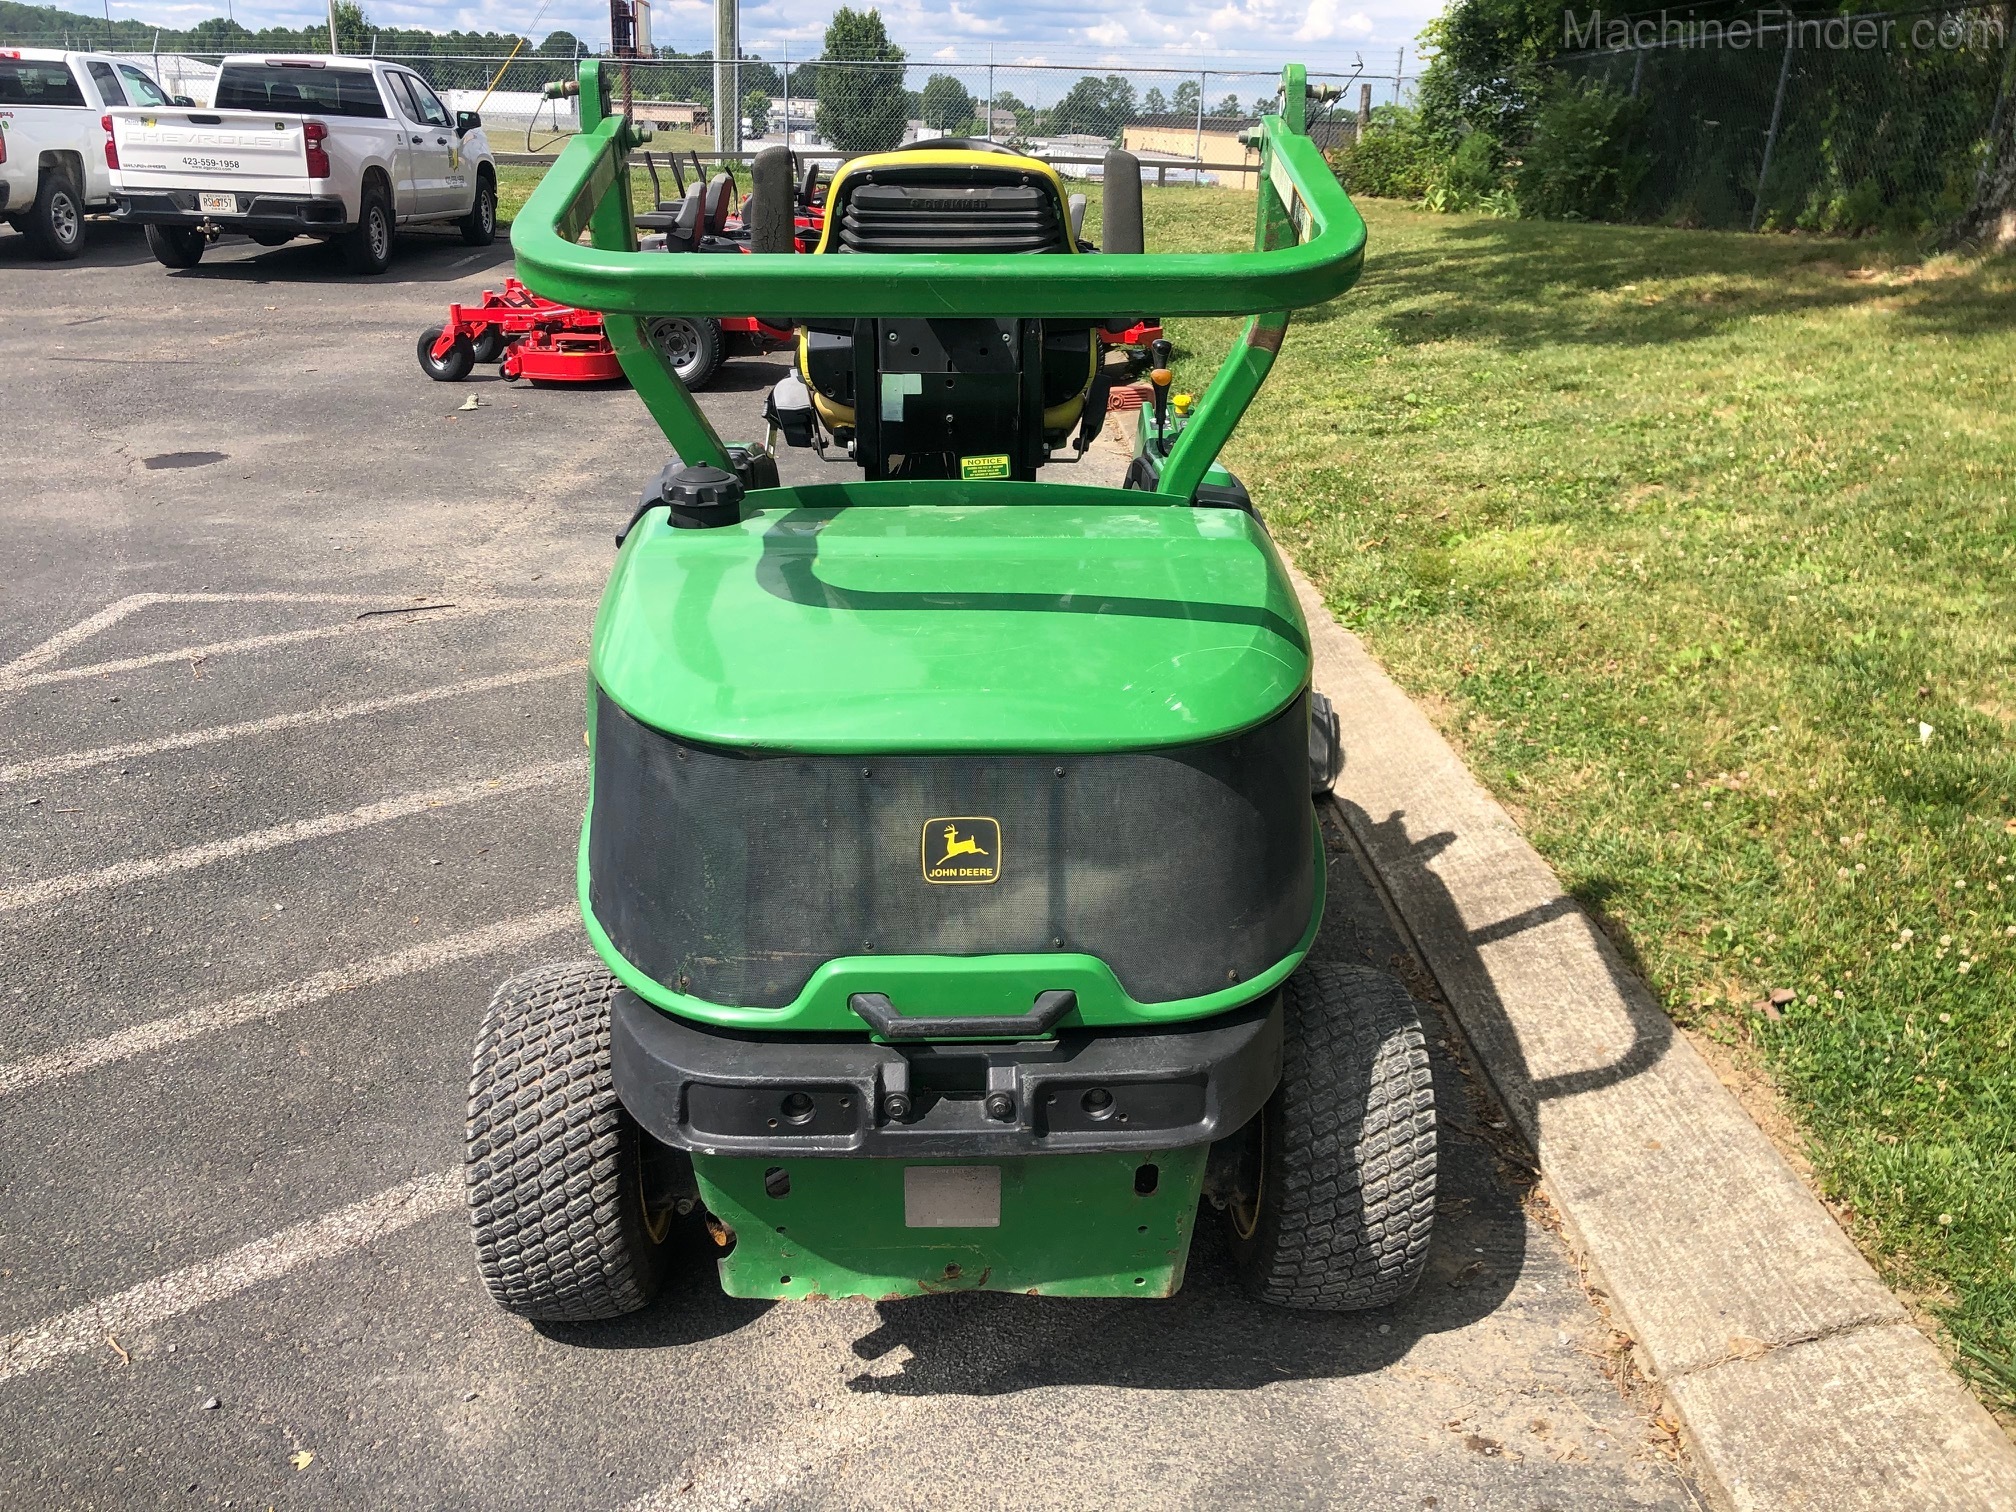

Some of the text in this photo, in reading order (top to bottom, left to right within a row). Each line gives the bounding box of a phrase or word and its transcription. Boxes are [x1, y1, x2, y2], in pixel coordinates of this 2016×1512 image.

[125, 131, 291, 149] CHEVROLET
[182, 157, 240, 169] 423-559-1958
[967, 457, 1003, 466] NOTICE
[929, 868, 993, 877] JOHN DEERE
